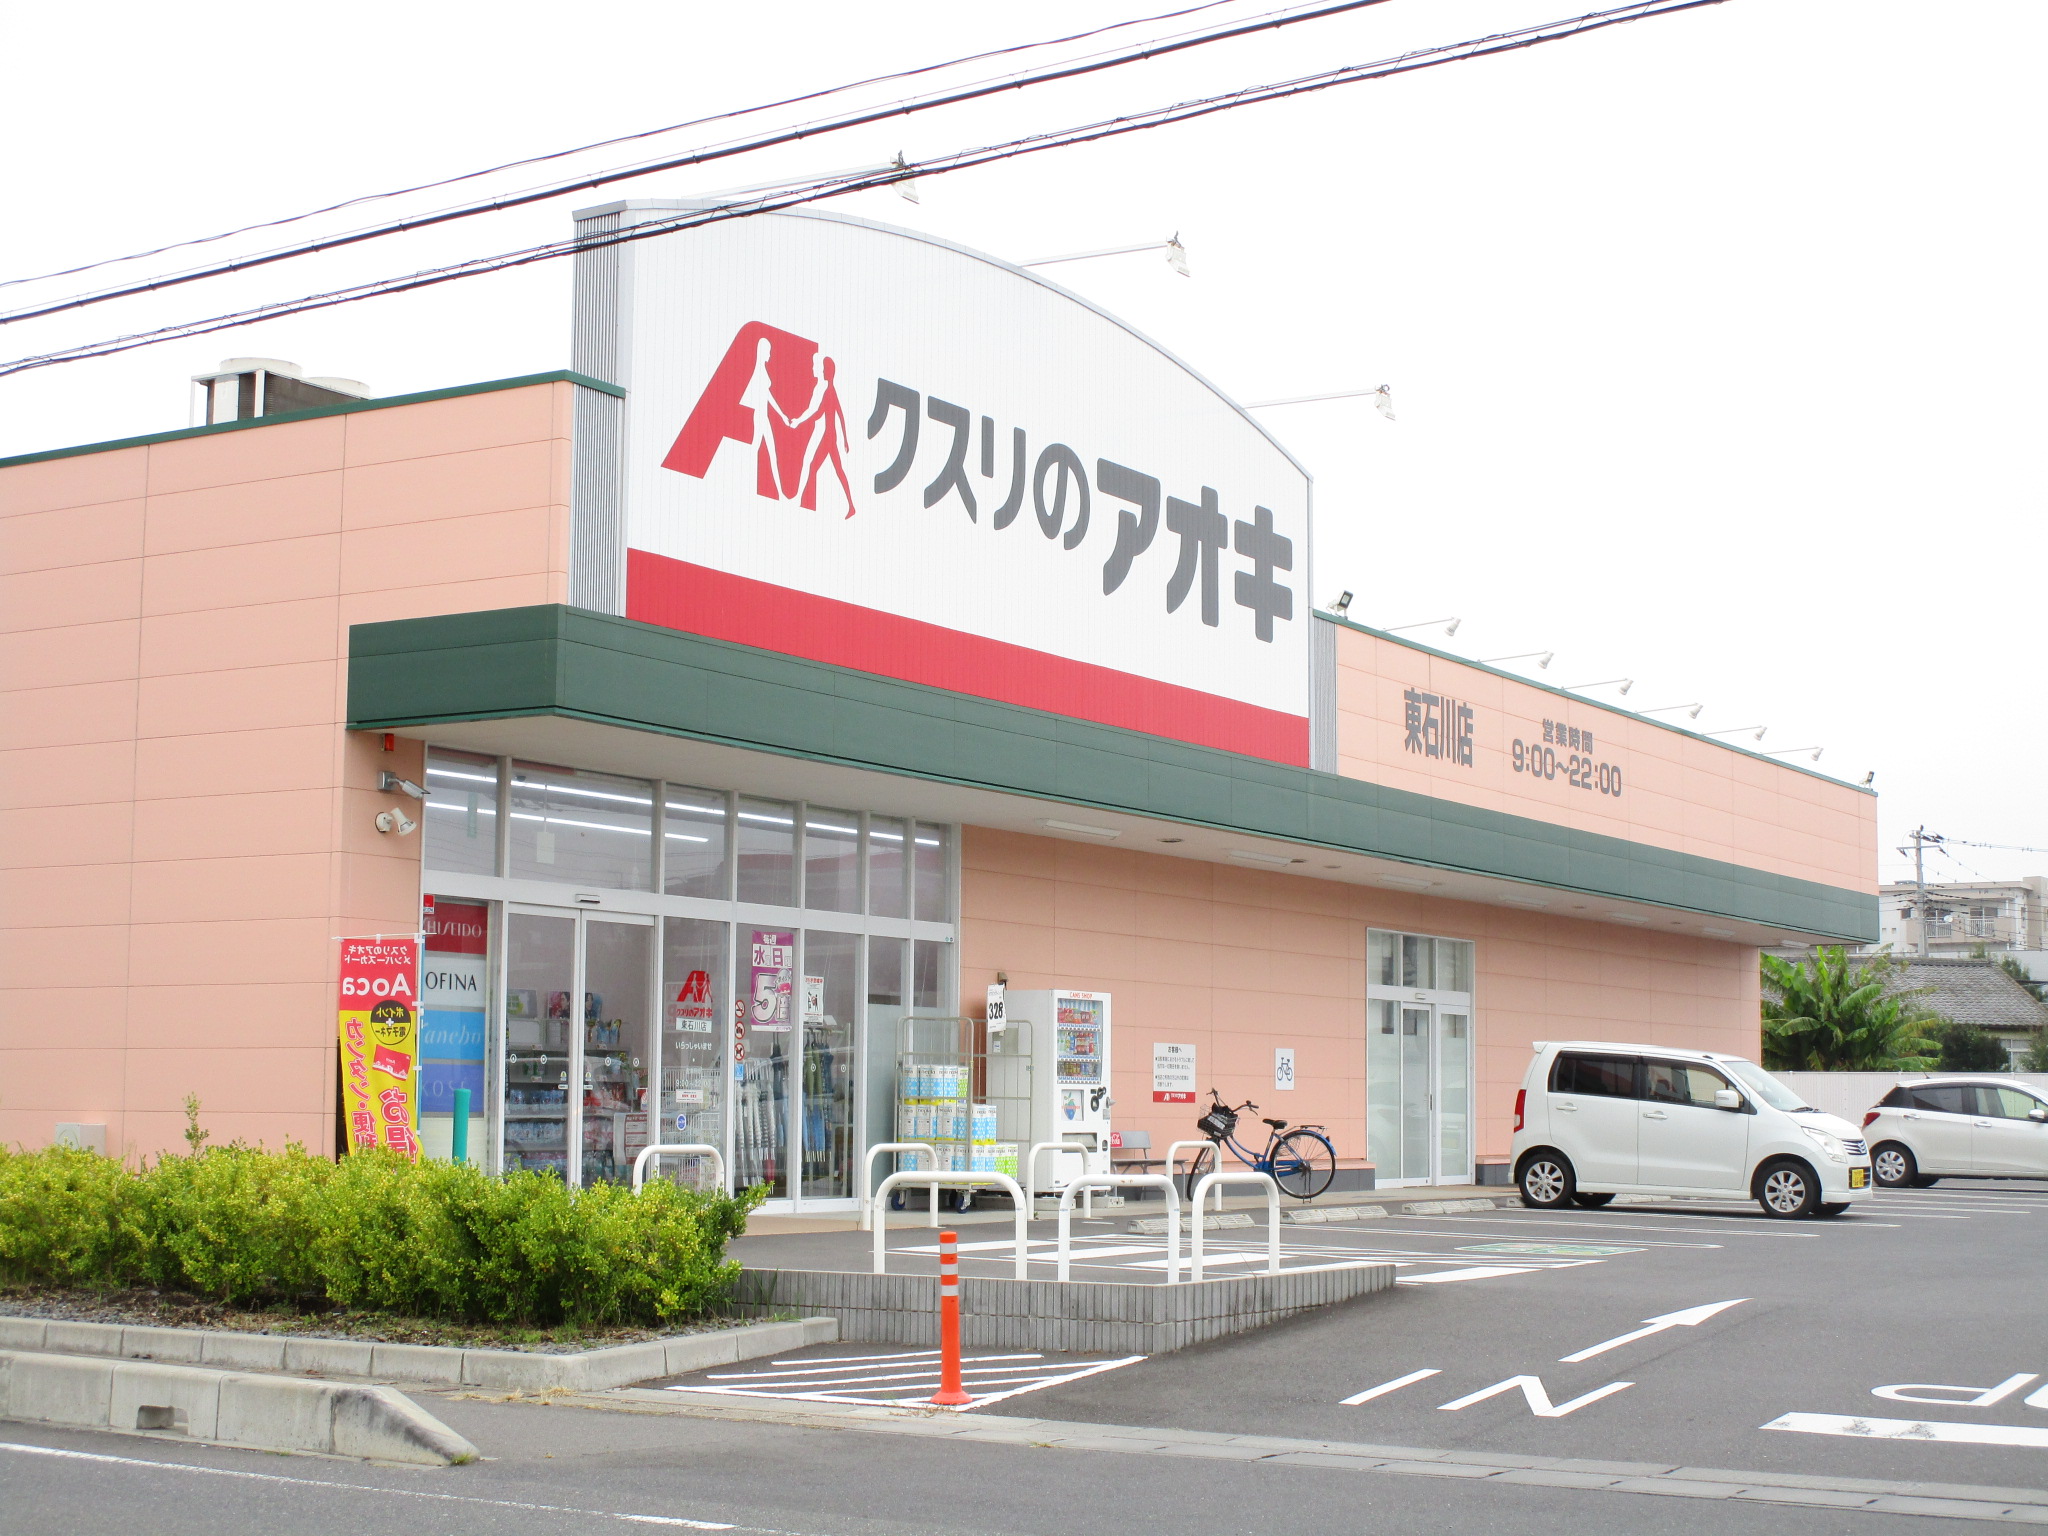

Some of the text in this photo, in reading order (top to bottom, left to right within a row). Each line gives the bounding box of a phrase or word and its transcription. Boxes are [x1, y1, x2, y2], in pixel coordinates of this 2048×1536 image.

[867, 377, 1293, 644] クスリのアオキ
[1403, 687, 1474, 768] 東石川店
[1542, 718, 1593, 755] 営業時間
[425, 971, 477, 991] OFINA
[988, 1002, 1004, 1020] 328
[423, 1023, 481, 1045] anebo
[681, 1020, 707, 1031] 東石川店
[675, 1041, 712, 1050] いらっしゃいませ
[1338, 1368, 1637, 1418] IN
